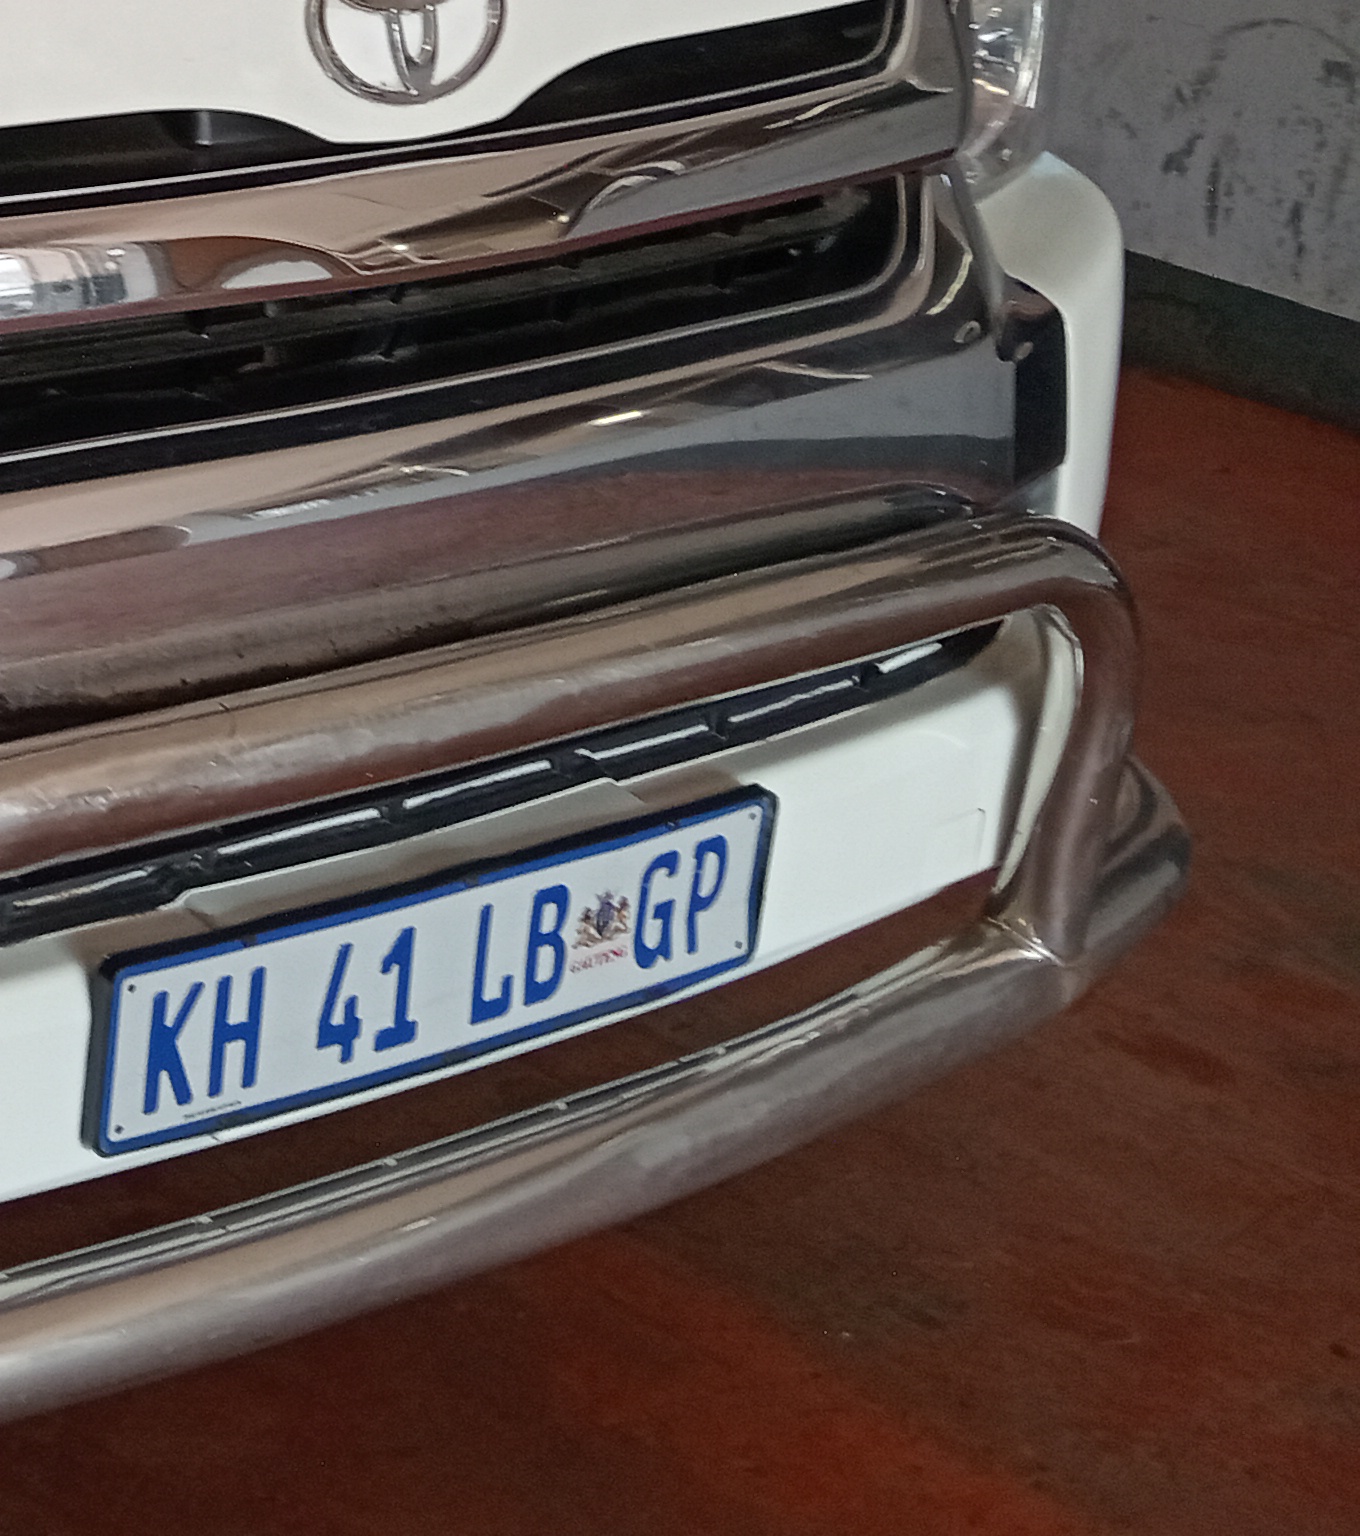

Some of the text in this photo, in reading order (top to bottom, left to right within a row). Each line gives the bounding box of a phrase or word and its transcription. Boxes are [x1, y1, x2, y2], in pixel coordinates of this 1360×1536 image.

[142, 833, 728, 1115] KH 41 LB GP
